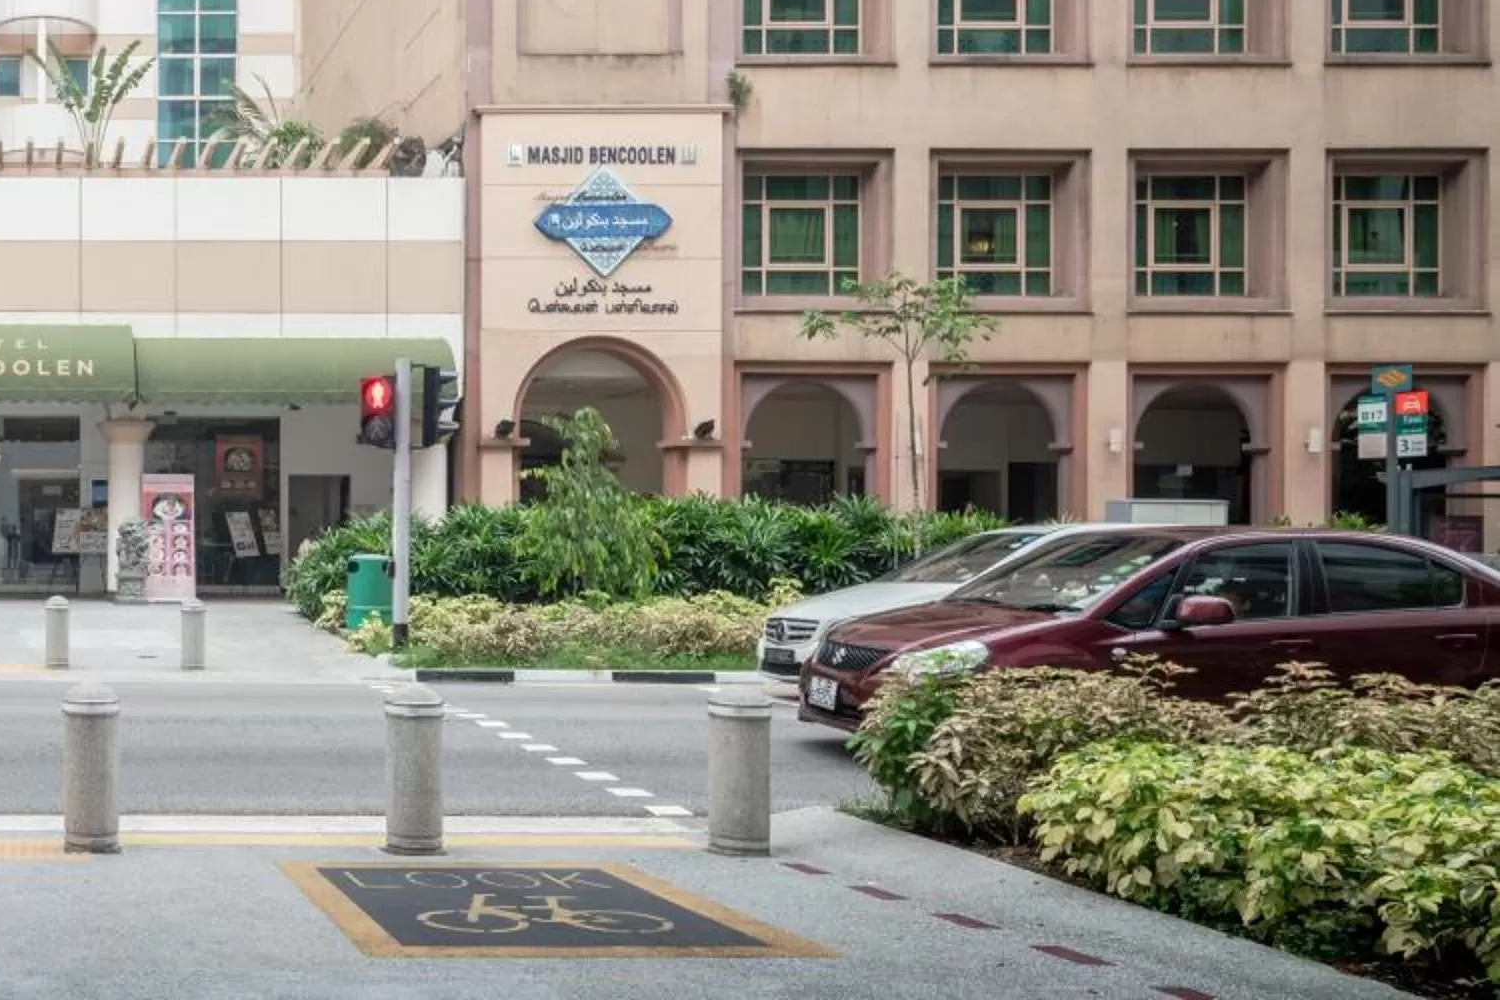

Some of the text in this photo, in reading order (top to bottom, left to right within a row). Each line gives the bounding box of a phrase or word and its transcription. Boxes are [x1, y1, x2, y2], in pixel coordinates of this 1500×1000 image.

[527, 145, 676, 165] MASJID BENCOOLEN
[343, 871, 612, 889] LOOK
